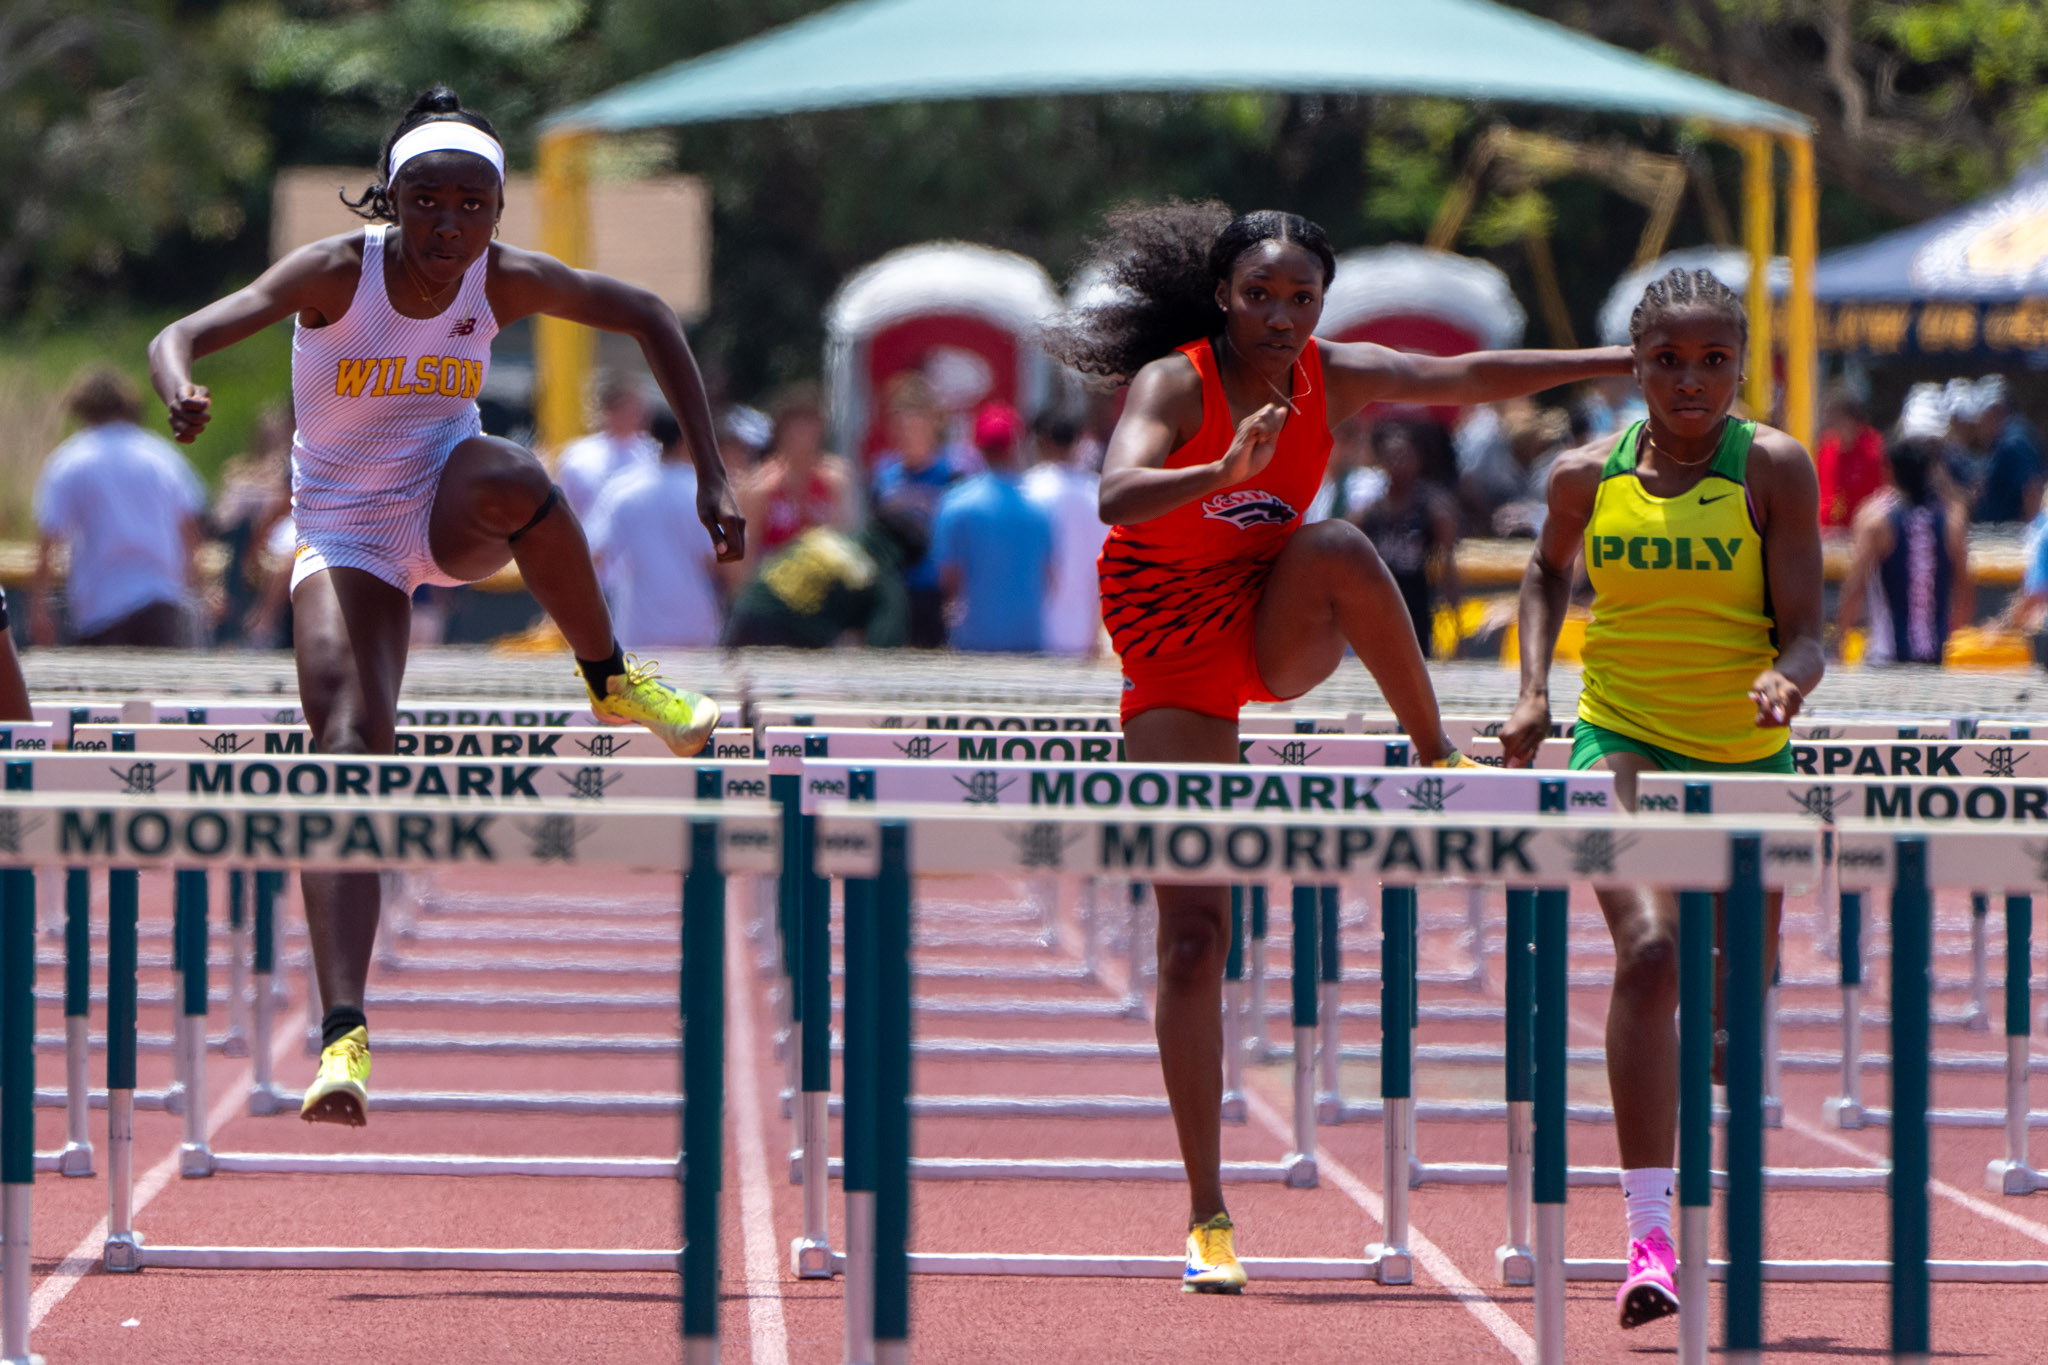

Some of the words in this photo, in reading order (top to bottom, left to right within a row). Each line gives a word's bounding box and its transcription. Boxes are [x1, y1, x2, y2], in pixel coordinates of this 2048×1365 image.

[336, 355, 482, 399] WILSON
[1592, 535, 1743, 571] POLY
[188, 762, 543, 803] MOORPARK
[1030, 771, 1384, 813] MOORPARK
[60, 810, 497, 861] MOORPARK
[1102, 823, 1537, 873] MOORPARK
